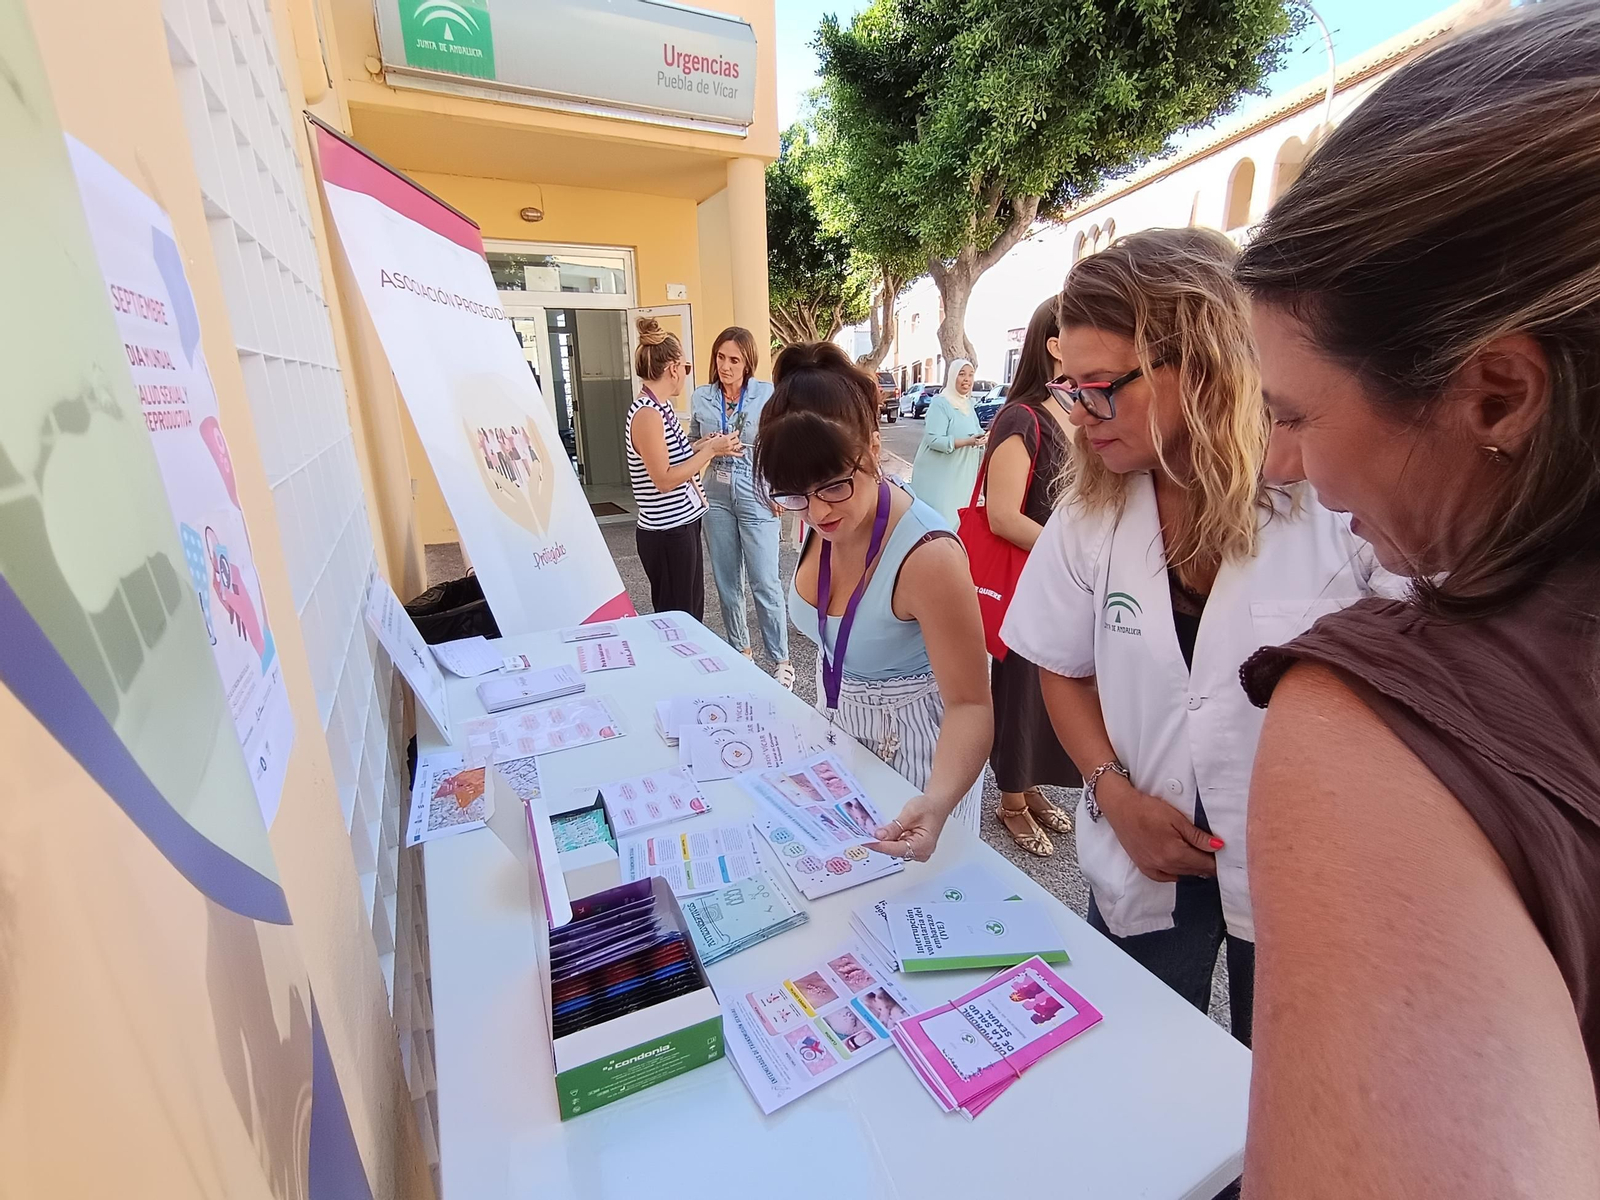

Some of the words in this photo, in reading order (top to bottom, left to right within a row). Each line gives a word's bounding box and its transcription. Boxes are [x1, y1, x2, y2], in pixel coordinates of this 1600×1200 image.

[416, 38, 437, 51] JUNTA
[439, 42, 448, 53] DE
[663, 43, 740, 79] Urgencias
[657, 71, 693, 92] Puebla
[696, 80, 710, 95] de
[712, 80, 738, 100] Vícar
[381, 269, 456, 308] ASOCIACIÓN
[111, 284, 168, 326] SEPTIEMBRE
[133, 385, 160, 405] ALUD
[914, 907, 923, 917] del
[906, 908, 925, 954] Interrupción
[918, 918, 935, 955] voluntaria
[926, 914, 942, 949] embarazo
[936, 921, 949, 940] (IVE)
[968, 1004, 992, 1028] SALUD
[985, 1009, 1012, 1037] SEXUAL
[991, 1030, 1003, 1040] LA
[1001, 1040, 1014, 1052] DE
[615, 1044, 670, 1069] condonia
[750, 1047, 759, 1056] DE
[756, 1054, 778, 1084] ENFERMEDADES
